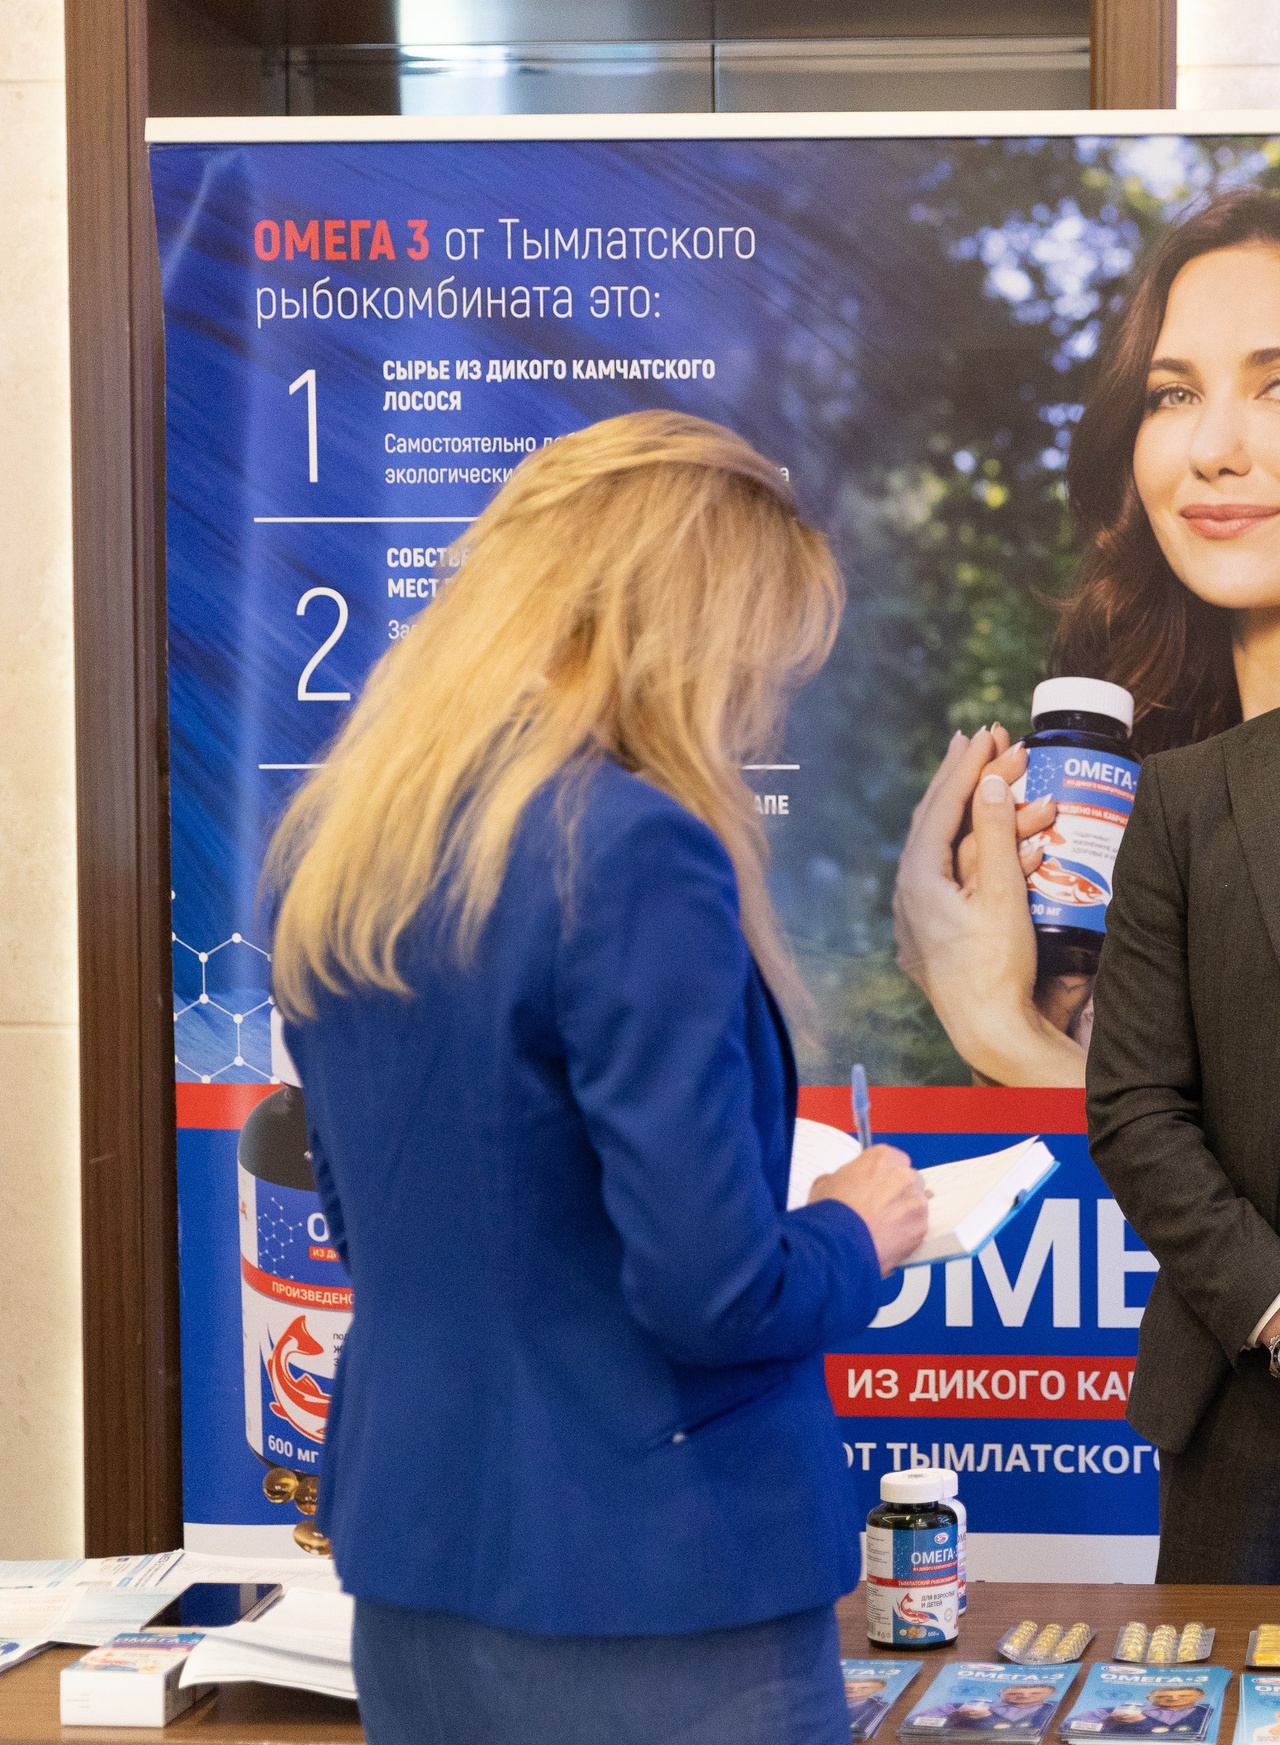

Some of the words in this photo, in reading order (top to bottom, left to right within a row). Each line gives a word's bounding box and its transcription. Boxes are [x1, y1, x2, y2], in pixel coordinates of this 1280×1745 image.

[254, 219, 397, 261] ОМЕГА
[406, 219, 430, 261] 3
[445, 226, 484, 261] от
[498, 218, 757, 261] Тымлатского
[256, 276, 574, 328] рыбокомбината
[590, 285, 661, 319] это:
[382, 360, 450, 380] СЫРЬЕ
[455, 360, 482, 380] ИЗ
[486, 359, 567, 383] ДИКОГО
[571, 358, 716, 380] КАМЧАТСКОГО
[382, 391, 462, 411] ЛОСОСЯ
[288, 369, 319, 483] 1
[384, 433, 537, 453] Самостоятельно
[385, 467, 514, 484] экологически
[387, 578, 451, 598] МЕСТ
[296, 586, 351, 701] 2
[754, 794, 790, 815] АПЕ
[847, 1368, 899, 1399] ИЗ
[909, 1369, 1066, 1402] ДИКОГО
[1077, 1370, 1134, 1401] КА
[267, 1434, 294, 1458] 600
[885, 1442, 1161, 1474] ТЫМЛАТСКОГ
[921, 1594, 933, 1602] ДЛЯ
[926, 1600, 943, 1609] ДЕТЕЙ
